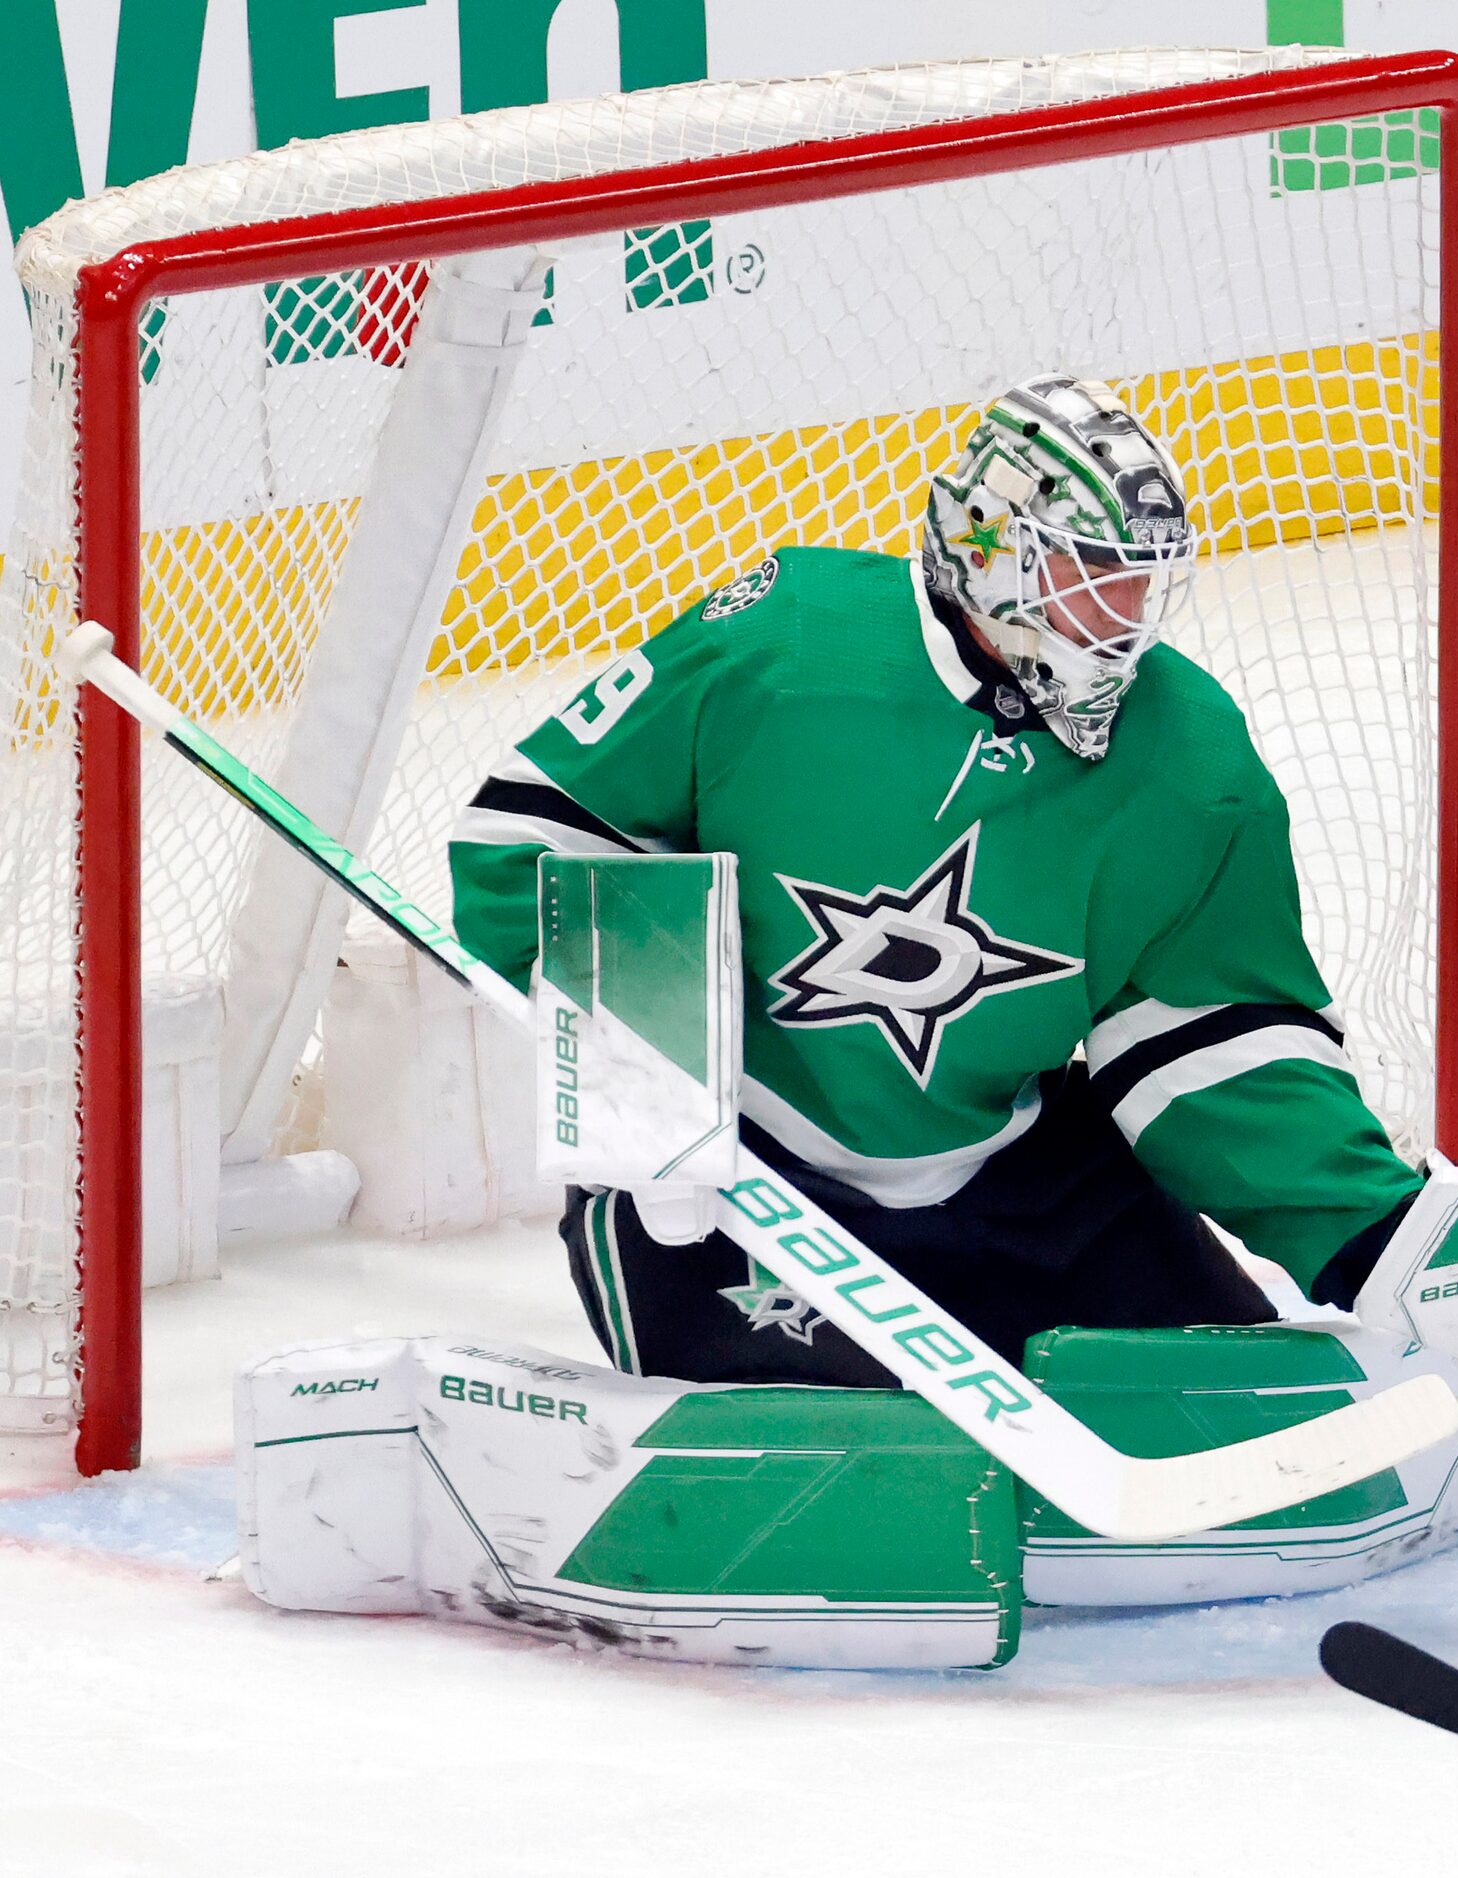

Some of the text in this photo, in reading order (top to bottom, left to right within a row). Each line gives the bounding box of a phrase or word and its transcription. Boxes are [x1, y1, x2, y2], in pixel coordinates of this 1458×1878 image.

[555, 1006, 579, 1149] BAUER
[717, 1177, 1033, 1424] BAUER
[290, 1376, 380, 1398] MACH
[439, 1373, 589, 1426] BAUER
